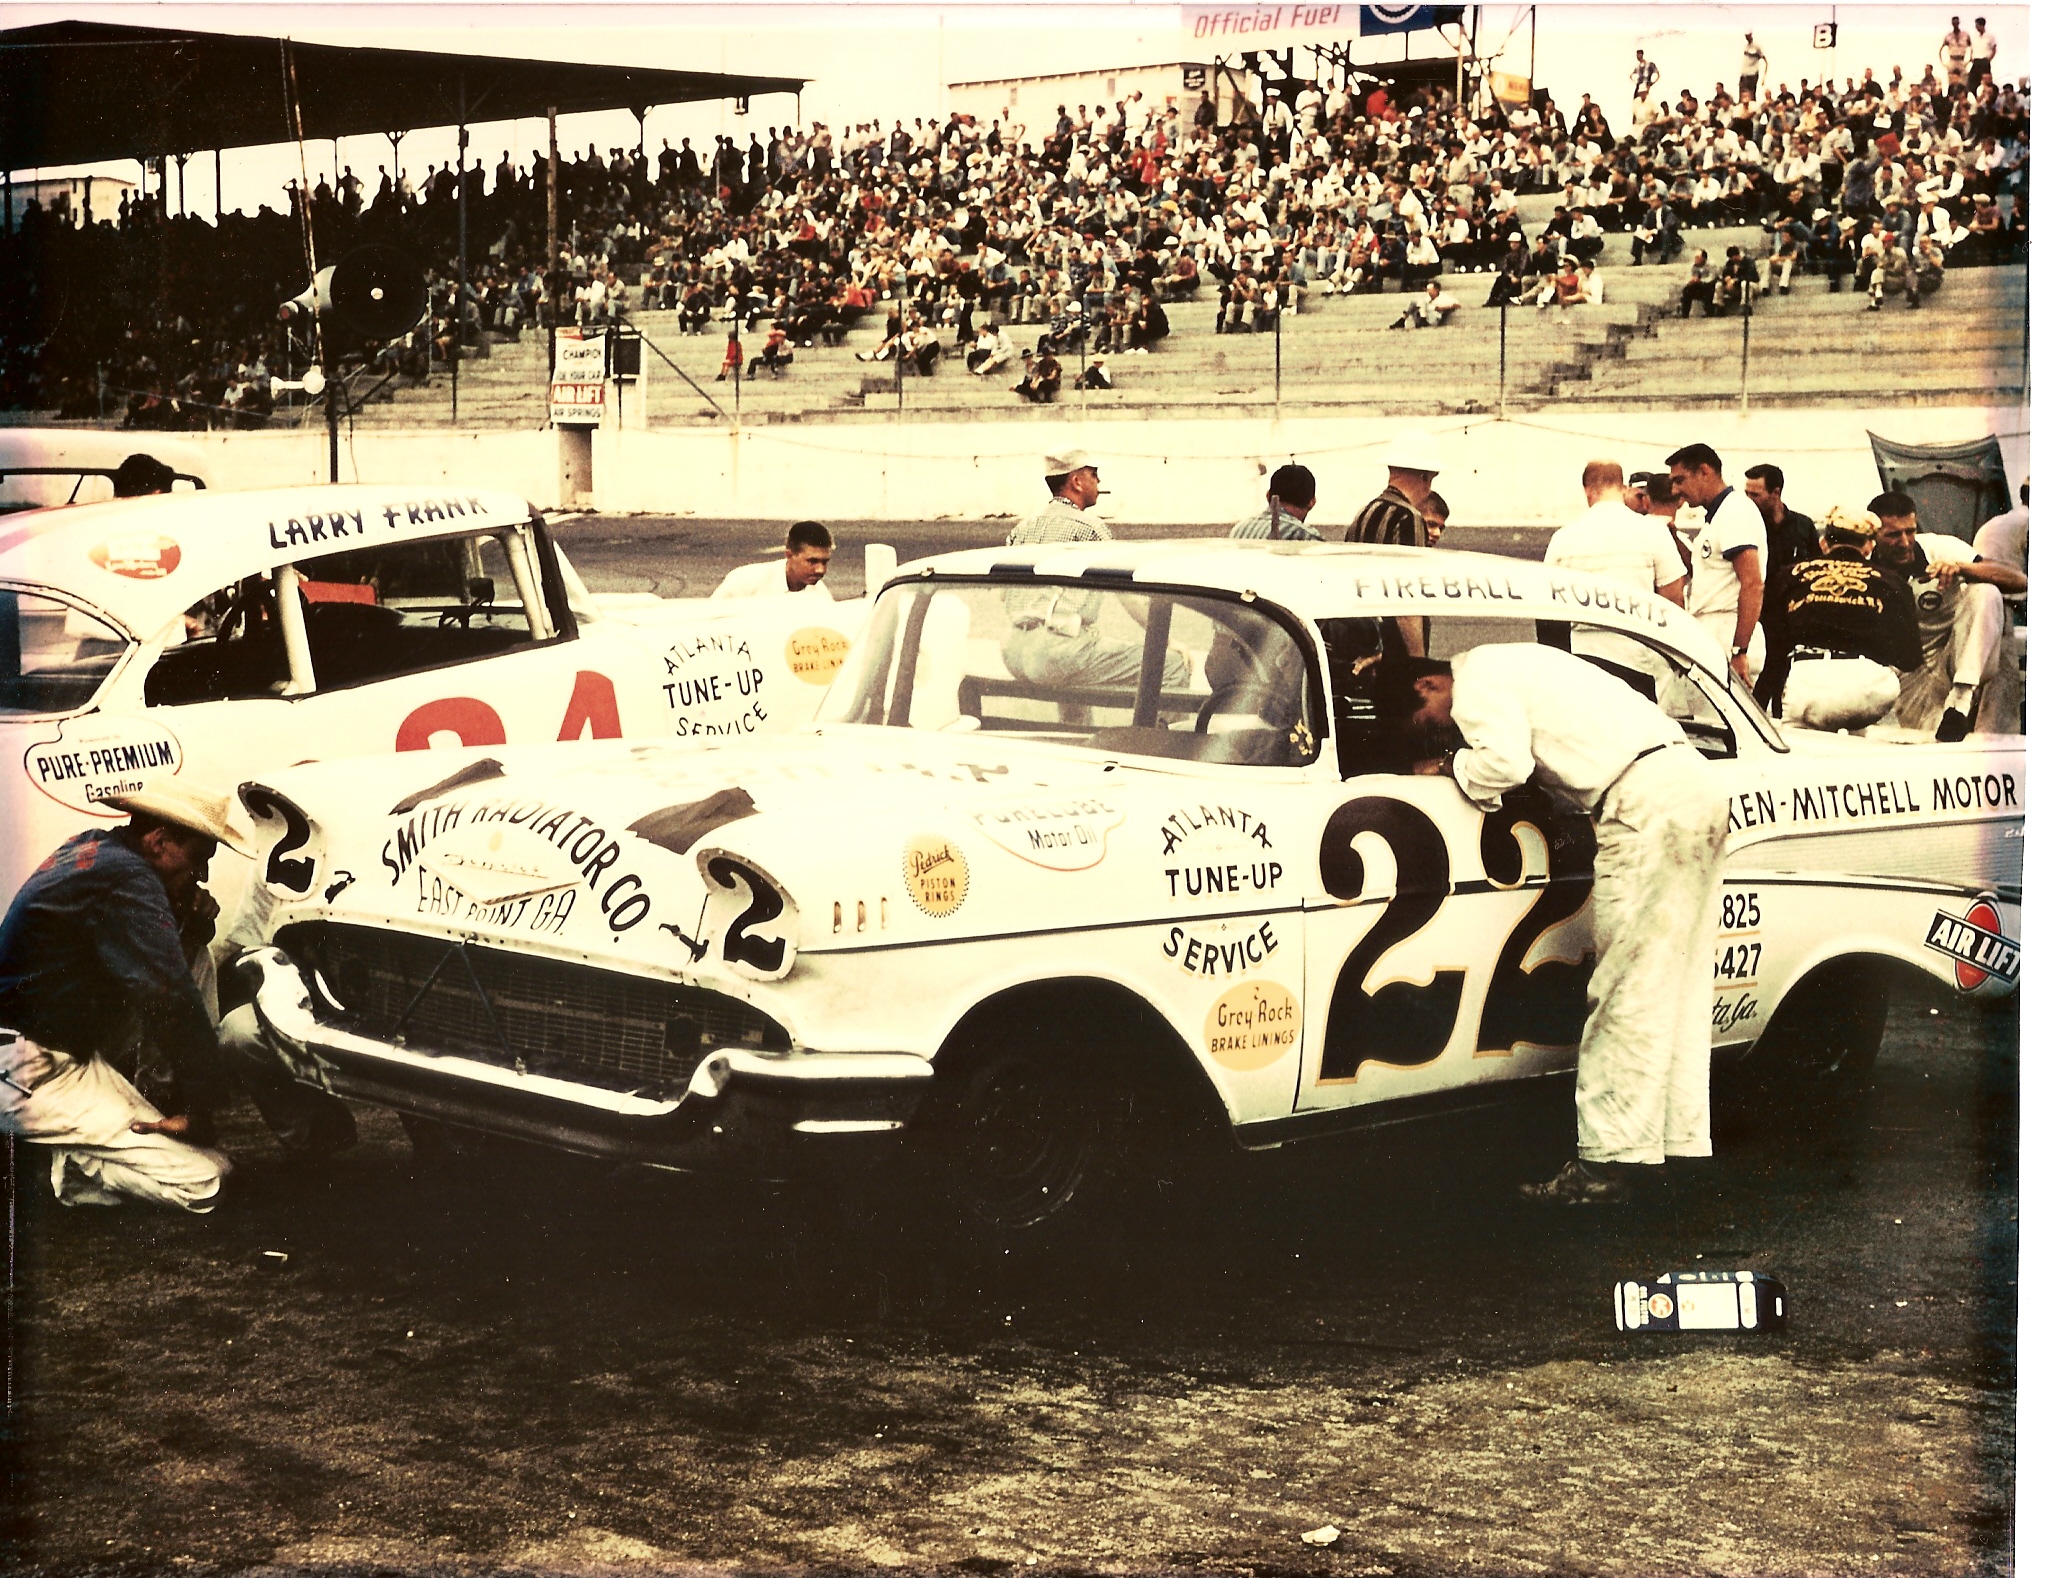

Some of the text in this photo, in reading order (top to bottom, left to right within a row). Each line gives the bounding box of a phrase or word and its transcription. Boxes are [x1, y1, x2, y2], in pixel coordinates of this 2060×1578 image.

[1194, 5, 1341, 38] Official Fuel
[1815, 25, 1833, 48] B
[554, 385, 602, 403] AIR LIFT
[554, 408, 601, 418] AIR SPRINGS
[269, 497, 488, 549] LARRY FRANK
[1355, 576, 1668, 627] FIREBALL ROBERTS
[663, 634, 752, 676] ATLANTA
[793, 660, 819, 673] BRAKE
[663, 668, 764, 709] TUNE-UP
[1933, 773, 2018, 811] MOTOR
[245, 789, 315, 893] 2
[1027, 824, 1098, 850] Motor Oil
[1161, 805, 1273, 856] ATLANTA
[382, 799, 651, 943] SMITH RADIATOR CO.
[910, 844, 955, 878] Pedrick
[1165, 862, 1283, 897] TUNE-UP
[417, 864, 464, 915] EAST
[465, 897, 532, 927] POINT
[921, 878, 956, 890] PISTON
[925, 890, 956, 902] RINGS
[707, 857, 786, 972] 2
[1719, 892, 1761, 929] 825
[1163, 921, 1279, 975] SERVICE
[1315, 795, 1597, 1087] 22
[1930, 918, 2020, 976] AIR LIFT
[1211, 1029, 1294, 1053] BRAKE LININGS
